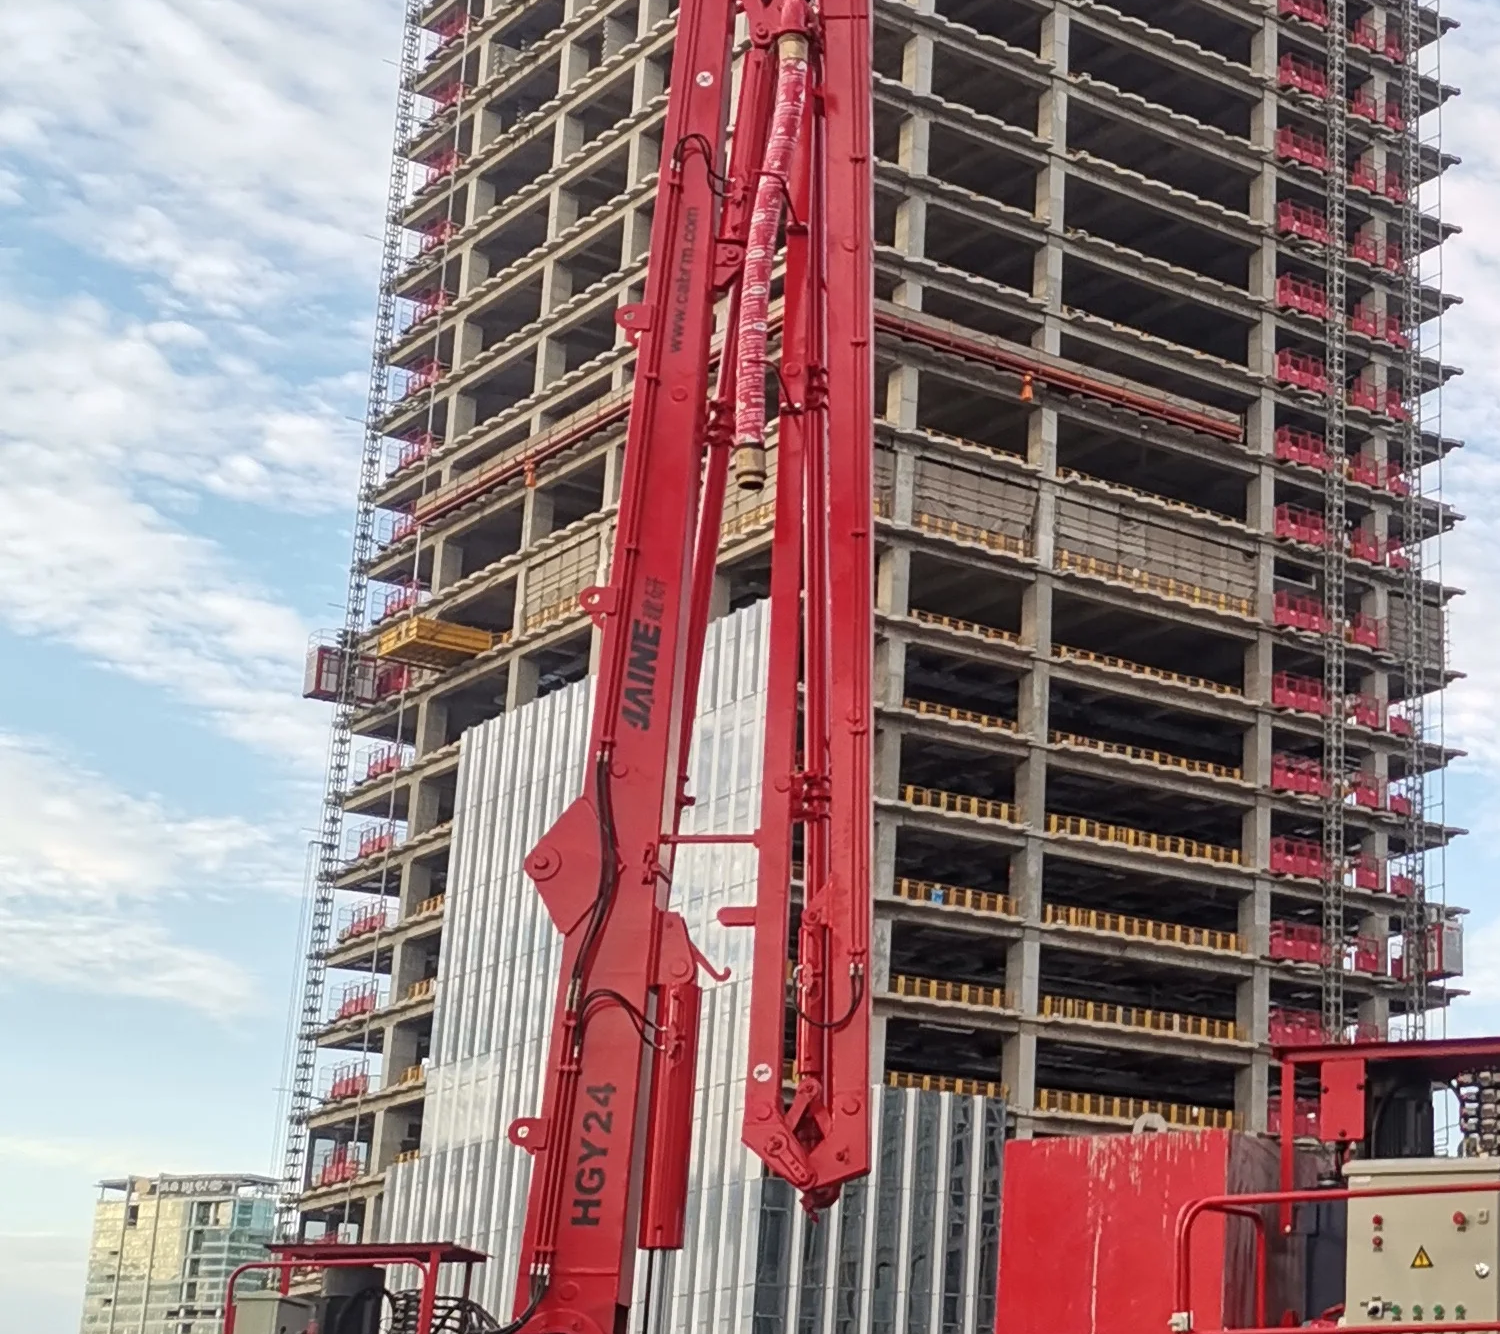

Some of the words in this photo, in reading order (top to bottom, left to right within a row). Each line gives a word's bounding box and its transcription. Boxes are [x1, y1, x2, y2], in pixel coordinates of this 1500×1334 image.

[669, 205, 701, 353] www.cabrm.com
[621, 618, 662, 732] JAINE
[570, 1082, 617, 1227] HGY24
